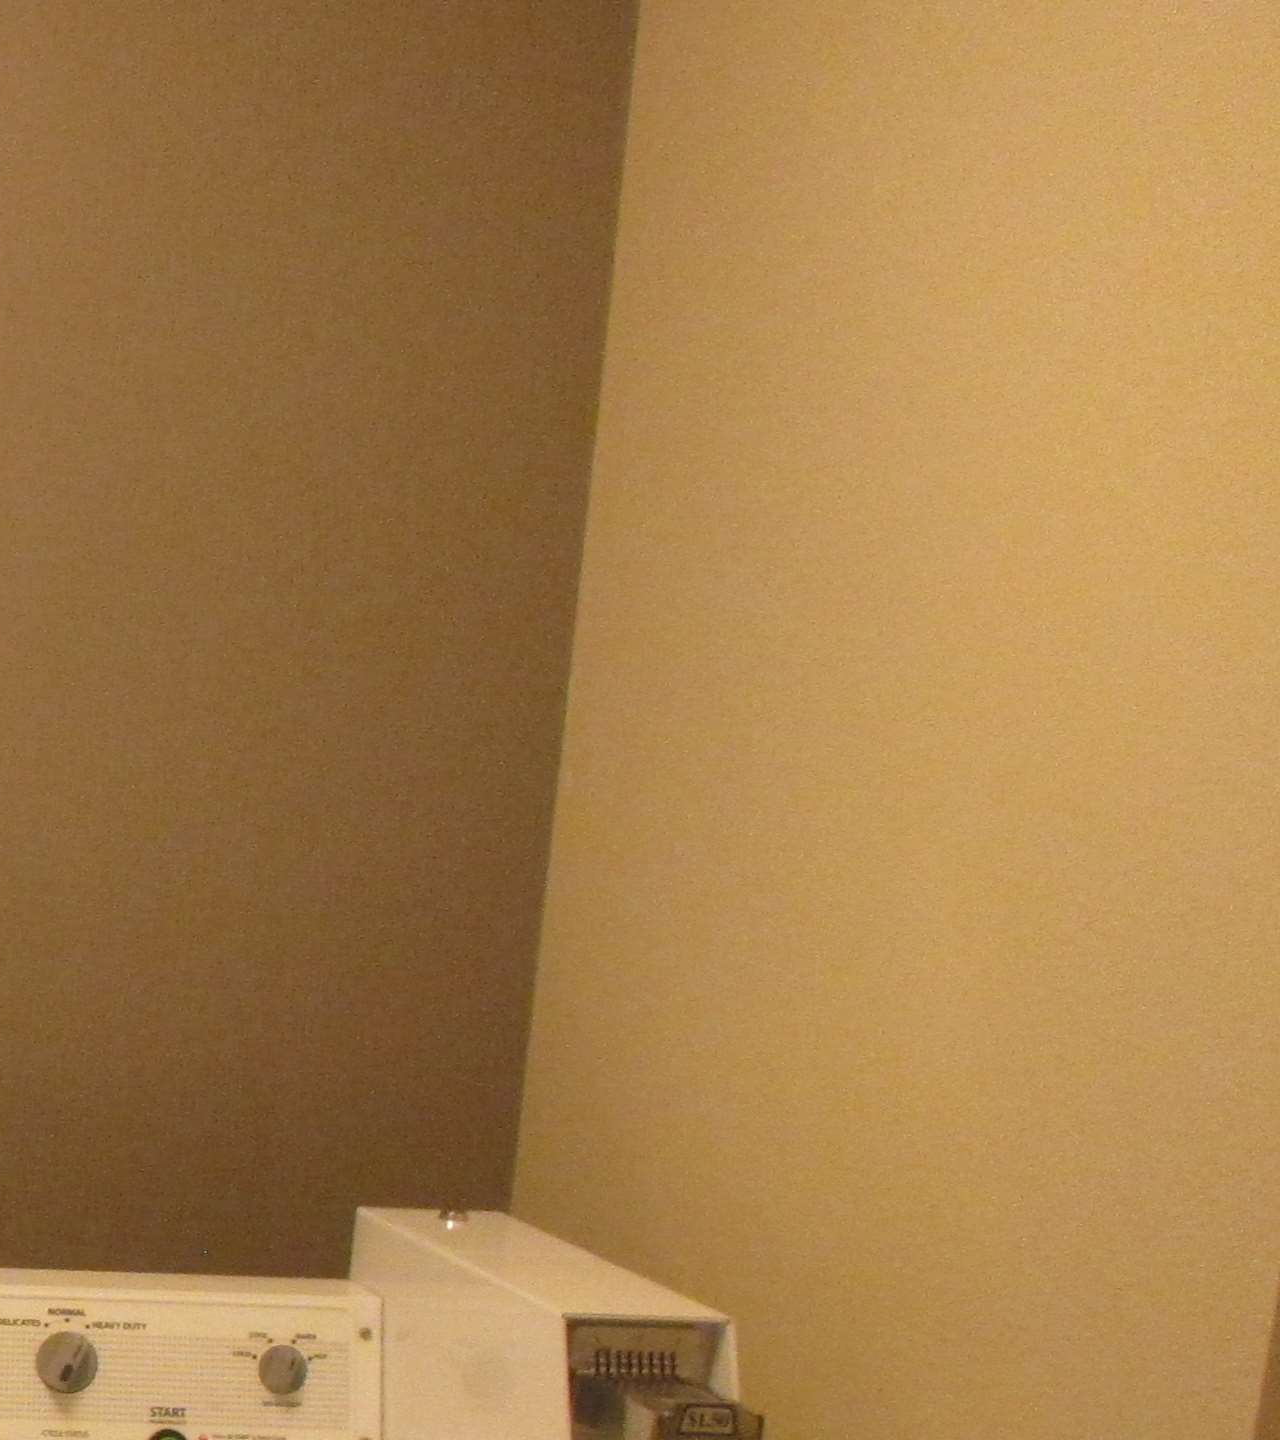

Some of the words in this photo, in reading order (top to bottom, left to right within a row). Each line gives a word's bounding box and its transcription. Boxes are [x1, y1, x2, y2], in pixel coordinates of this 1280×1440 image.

[47, 1308, 87, 1316] NORMAL
[92, 1321, 121, 1329] HEAVY
[122, 1322, 147, 1330] DUTY
[150, 1407, 187, 1418] START
